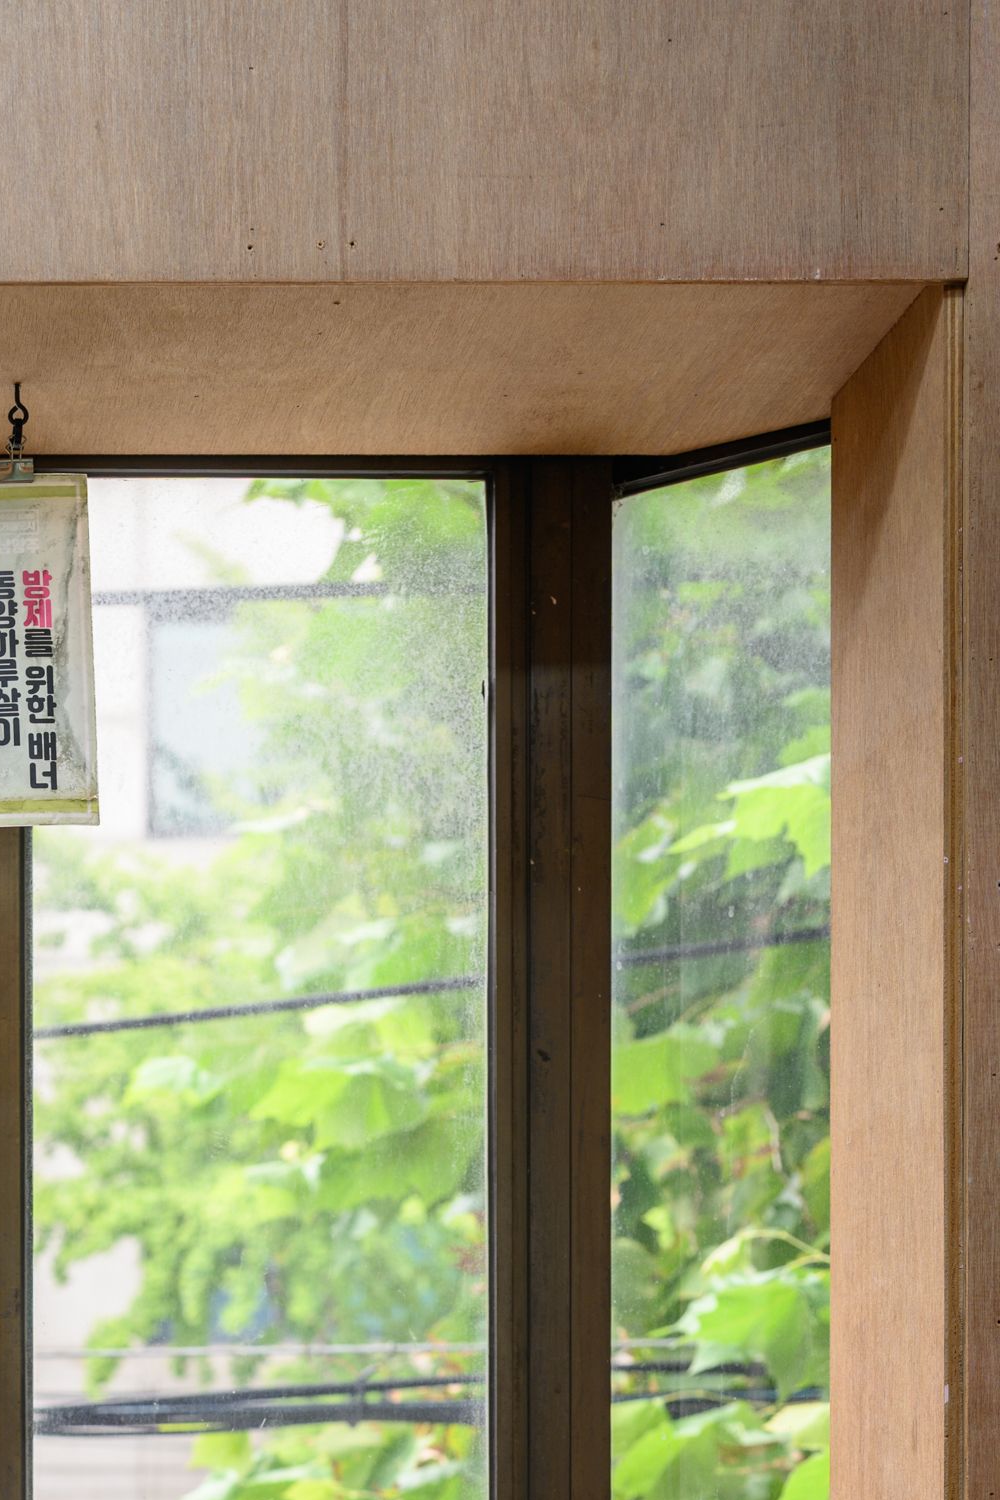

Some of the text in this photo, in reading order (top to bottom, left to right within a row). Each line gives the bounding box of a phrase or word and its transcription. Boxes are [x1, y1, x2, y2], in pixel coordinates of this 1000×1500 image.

[22, 569, 58, 790] 방제를 위한 배너
